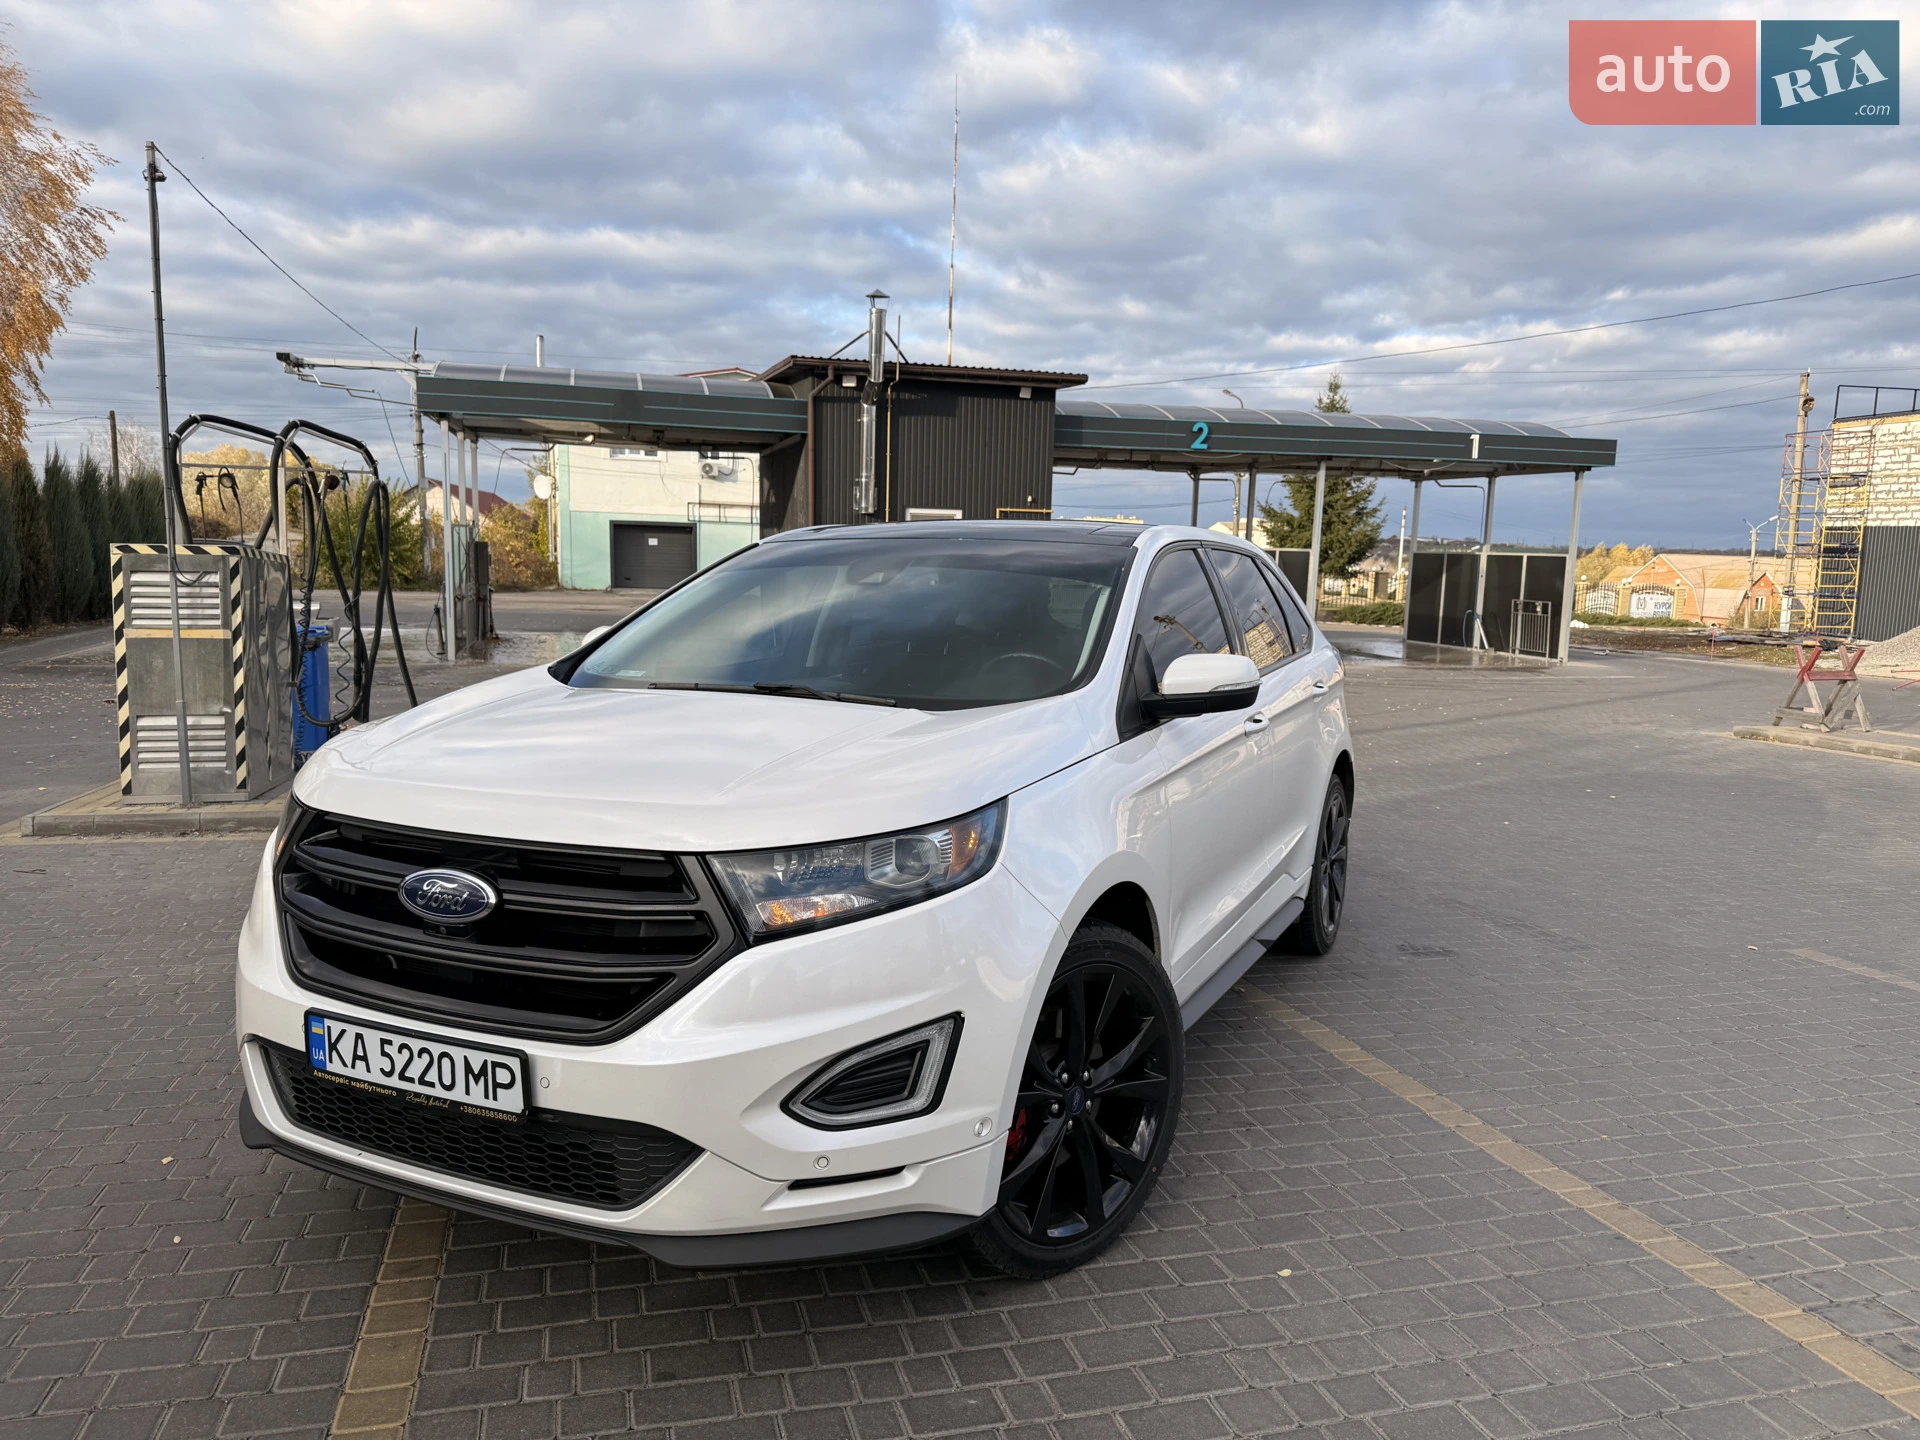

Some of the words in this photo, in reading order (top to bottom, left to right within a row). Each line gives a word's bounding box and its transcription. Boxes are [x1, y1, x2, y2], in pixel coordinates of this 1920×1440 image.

[1190, 421, 1209, 450] 2
[1469, 433, 1480, 459] 1
[416, 878, 470, 911] Ford
[312, 1047, 326, 1062] UA
[326, 1025, 371, 1074] KA
[379, 1037, 456, 1092] 5220
[463, 1054, 516, 1102] MP
[313, 1069, 350, 1085] Автосервіс
[350, 1080, 397, 1097] майбутнього
[460, 1105, 518, 1122] +380635858600
